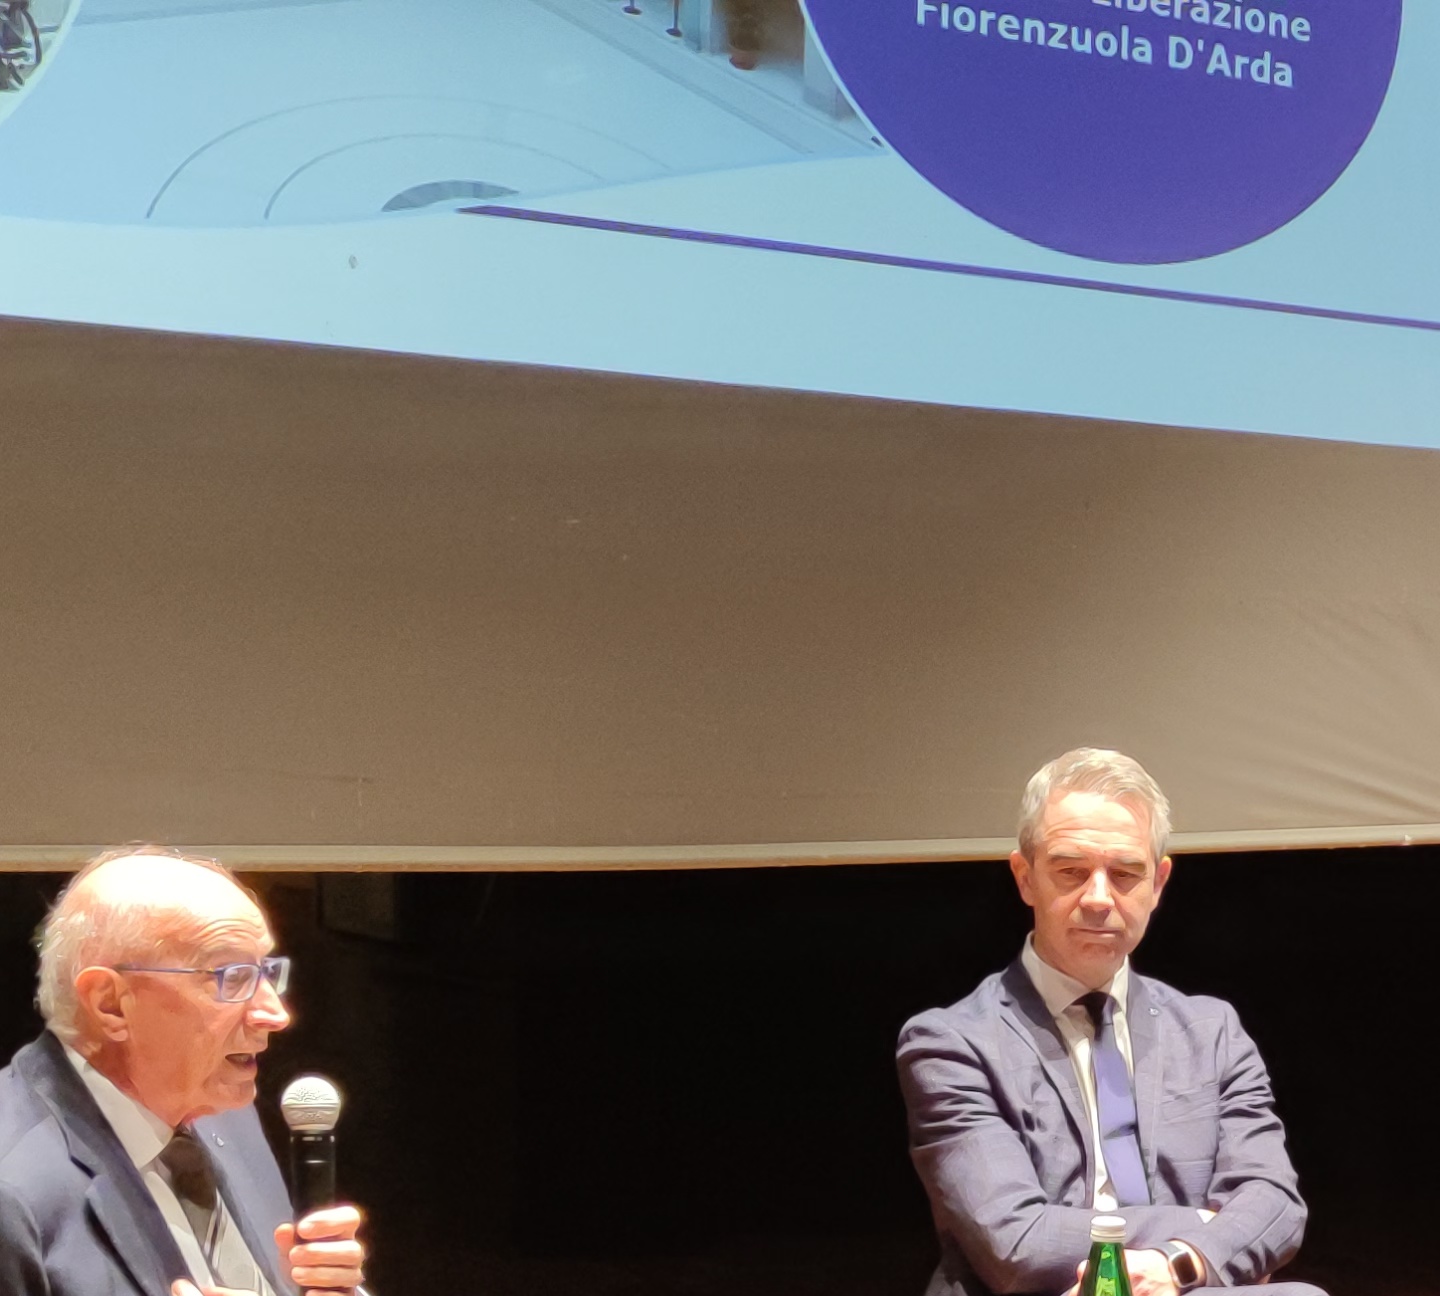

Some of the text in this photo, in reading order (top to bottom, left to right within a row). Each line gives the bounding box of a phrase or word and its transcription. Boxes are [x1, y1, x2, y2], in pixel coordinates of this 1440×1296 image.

[916, 0, 1294, 87] Fiorenzuola D'Arda
[1090, 0, 1312, 42] erazione
